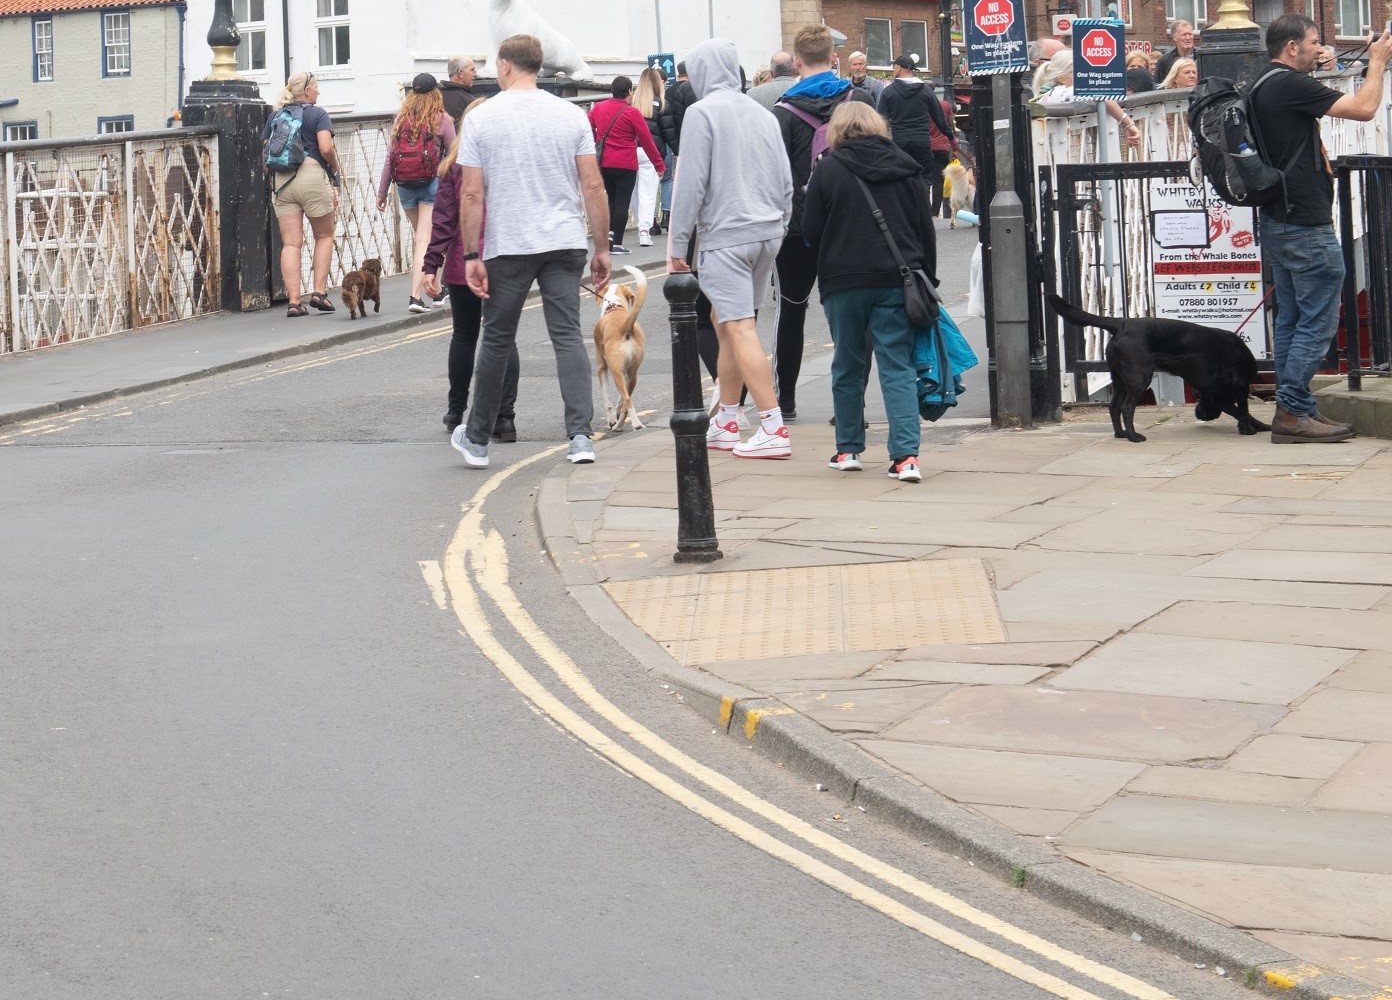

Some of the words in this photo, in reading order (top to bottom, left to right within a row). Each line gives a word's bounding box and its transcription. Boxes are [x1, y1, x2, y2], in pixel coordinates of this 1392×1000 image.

[988, 2, 999, 13] NO
[980, 13, 1009, 26] ACCESS
[1094, 36, 1104, 47] NO
[1086, 47, 1112, 57] ACCESS
[1157, 187, 1204, 197] WHITBY
[1160, 253, 1182, 261] From
[1184, 252, 1200, 261] the
[1201, 252, 1228, 260] Whale
[1230, 252, 1257, 260] Bones
[1175, 264, 1218, 273] WEBSITE
[1233, 263, 1257, 271] DATES
[1216, 282, 1241, 290] Child
[1179, 298, 1205, 306] 07880
[1207, 297, 1238, 306] 801957
